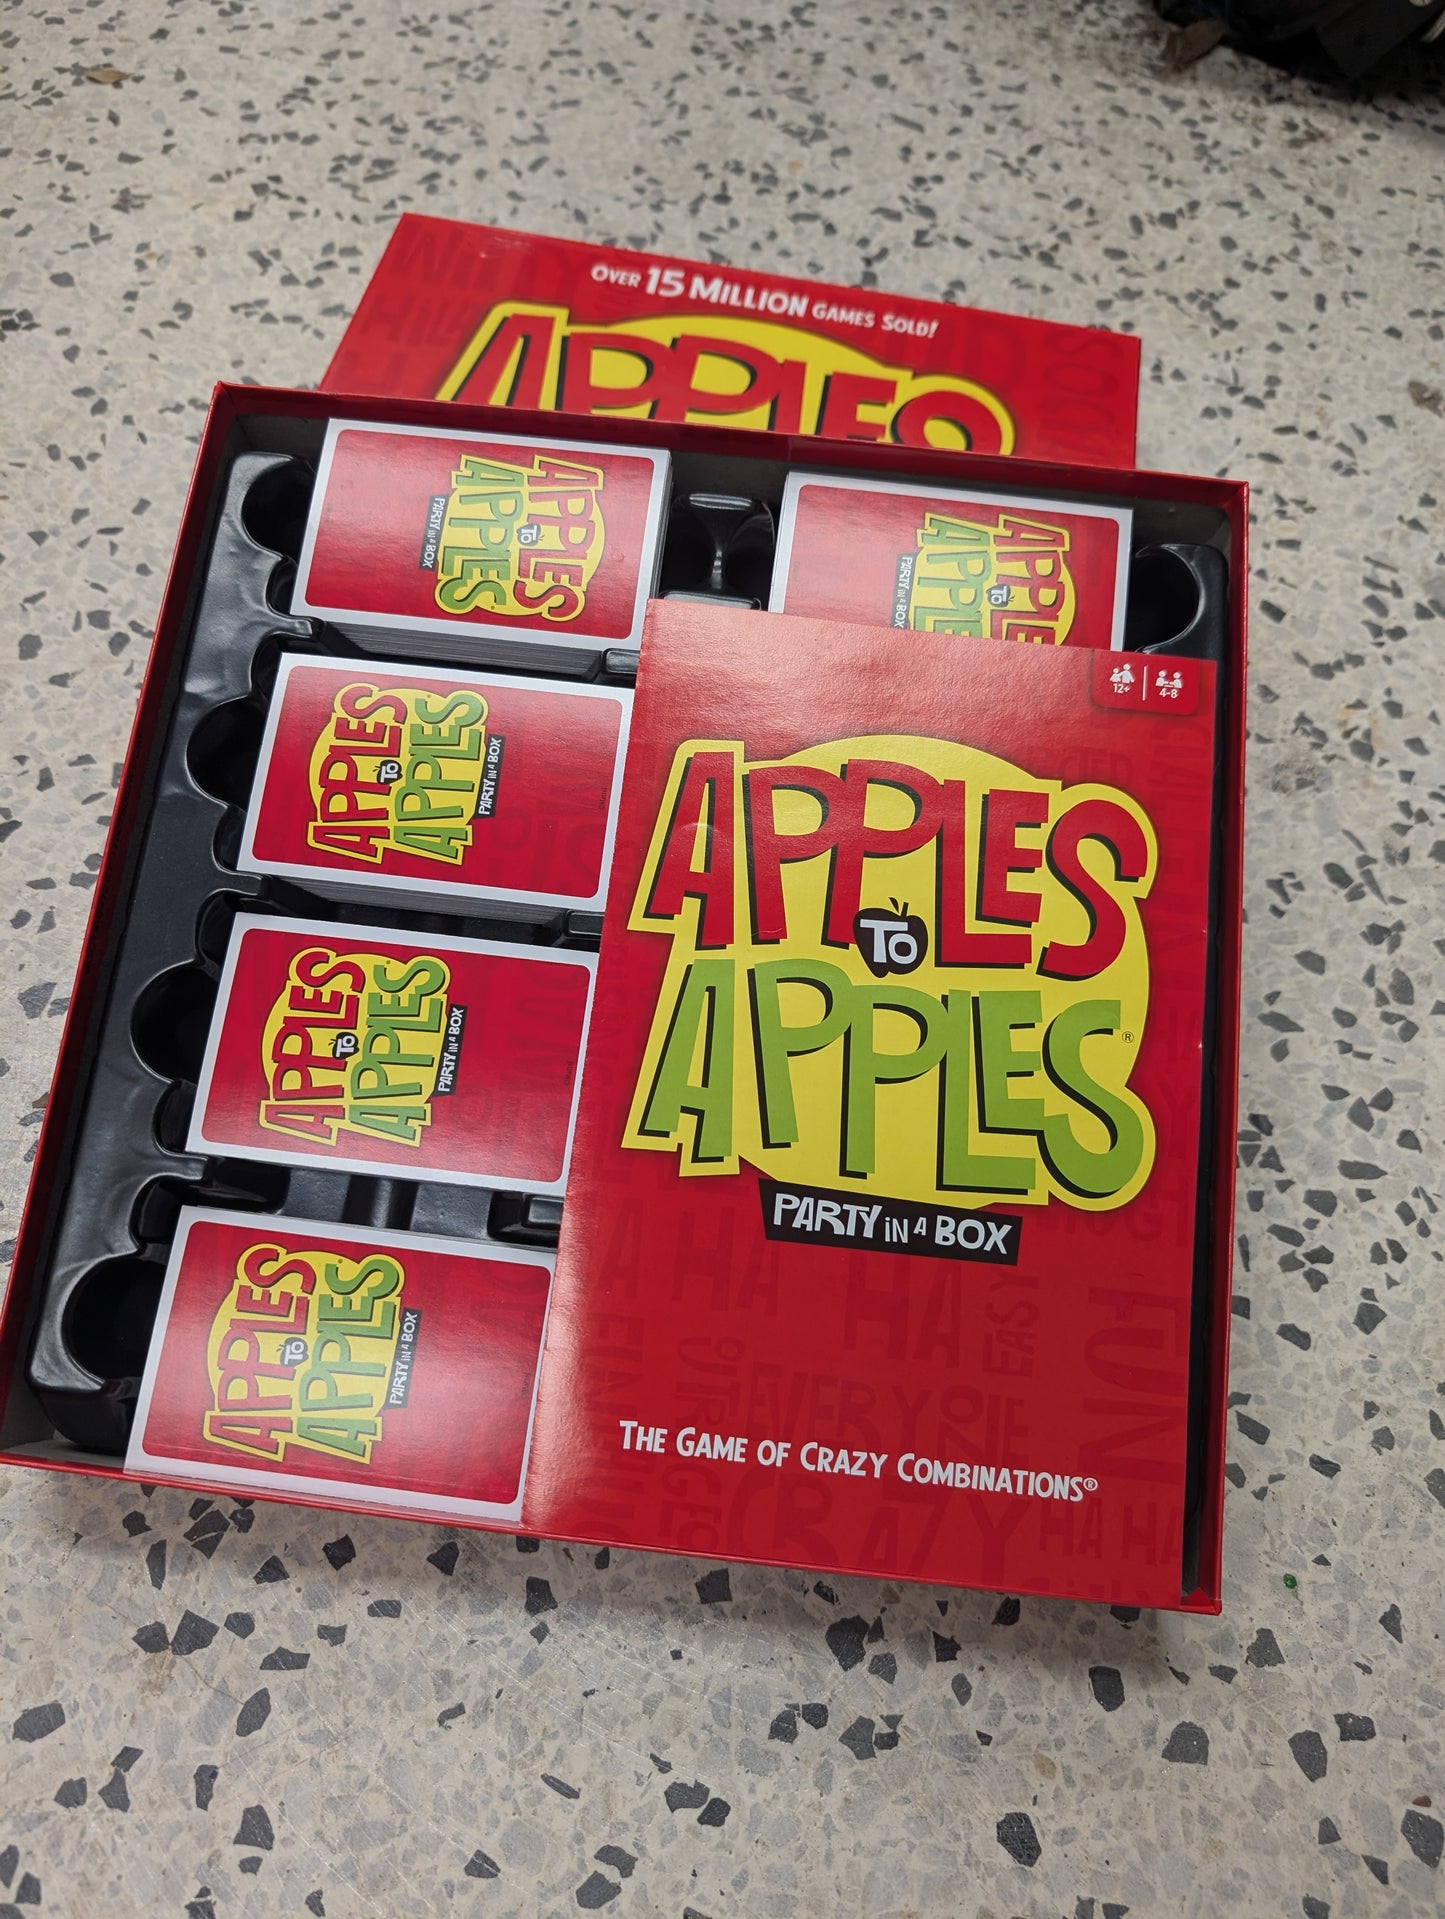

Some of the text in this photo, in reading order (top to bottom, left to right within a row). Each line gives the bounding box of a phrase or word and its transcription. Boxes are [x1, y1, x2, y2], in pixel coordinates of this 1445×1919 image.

[646, 266, 685, 298] 15
[689, 273, 809, 317] MILLION
[812, 302, 875, 328] GAMES
[881, 313, 939, 339] SOLD!
[422, 545, 436, 568] BOX
[430, 497, 446, 530] PARTY
[439, 458, 525, 611] APPLES
[513, 457, 601, 619] APPLES
[894, 604, 907, 628] BOX
[898, 556, 912, 590] PARTY
[914, 516, 993, 638] APPLE
[991, 515, 1066, 643] APPLE
[1113, 683, 1131, 694] 12+
[1159, 688, 1179, 699] 4-8
[313, 684, 409, 857] APPLES
[394, 692, 485, 860] APPLES
[478, 778, 496, 815] PARTY
[488, 737, 502, 763] BOX
[644, 752, 1149, 981] APPLES
[265, 951, 367, 1142] APPLES
[349, 959, 446, 1142] APPLES
[438, 1052, 456, 1092] PARTY
[448, 1007, 464, 1035] BOX
[773, 1192, 883, 1239] PARTY
[913, 1217, 927, 1236] A
[934, 1215, 1012, 1256] BOX
[208, 1247, 318, 1453] APPLES
[297, 1258, 401, 1457] APPLES
[389, 1361, 409, 1405] PARTY
[401, 1311, 418, 1342] BOX
[619, 1420, 668, 1454] THE
[676, 1426, 749, 1463] GAME
[756, 1440, 792, 1467] OF
[800, 1442, 888, 1479] CRAZY
